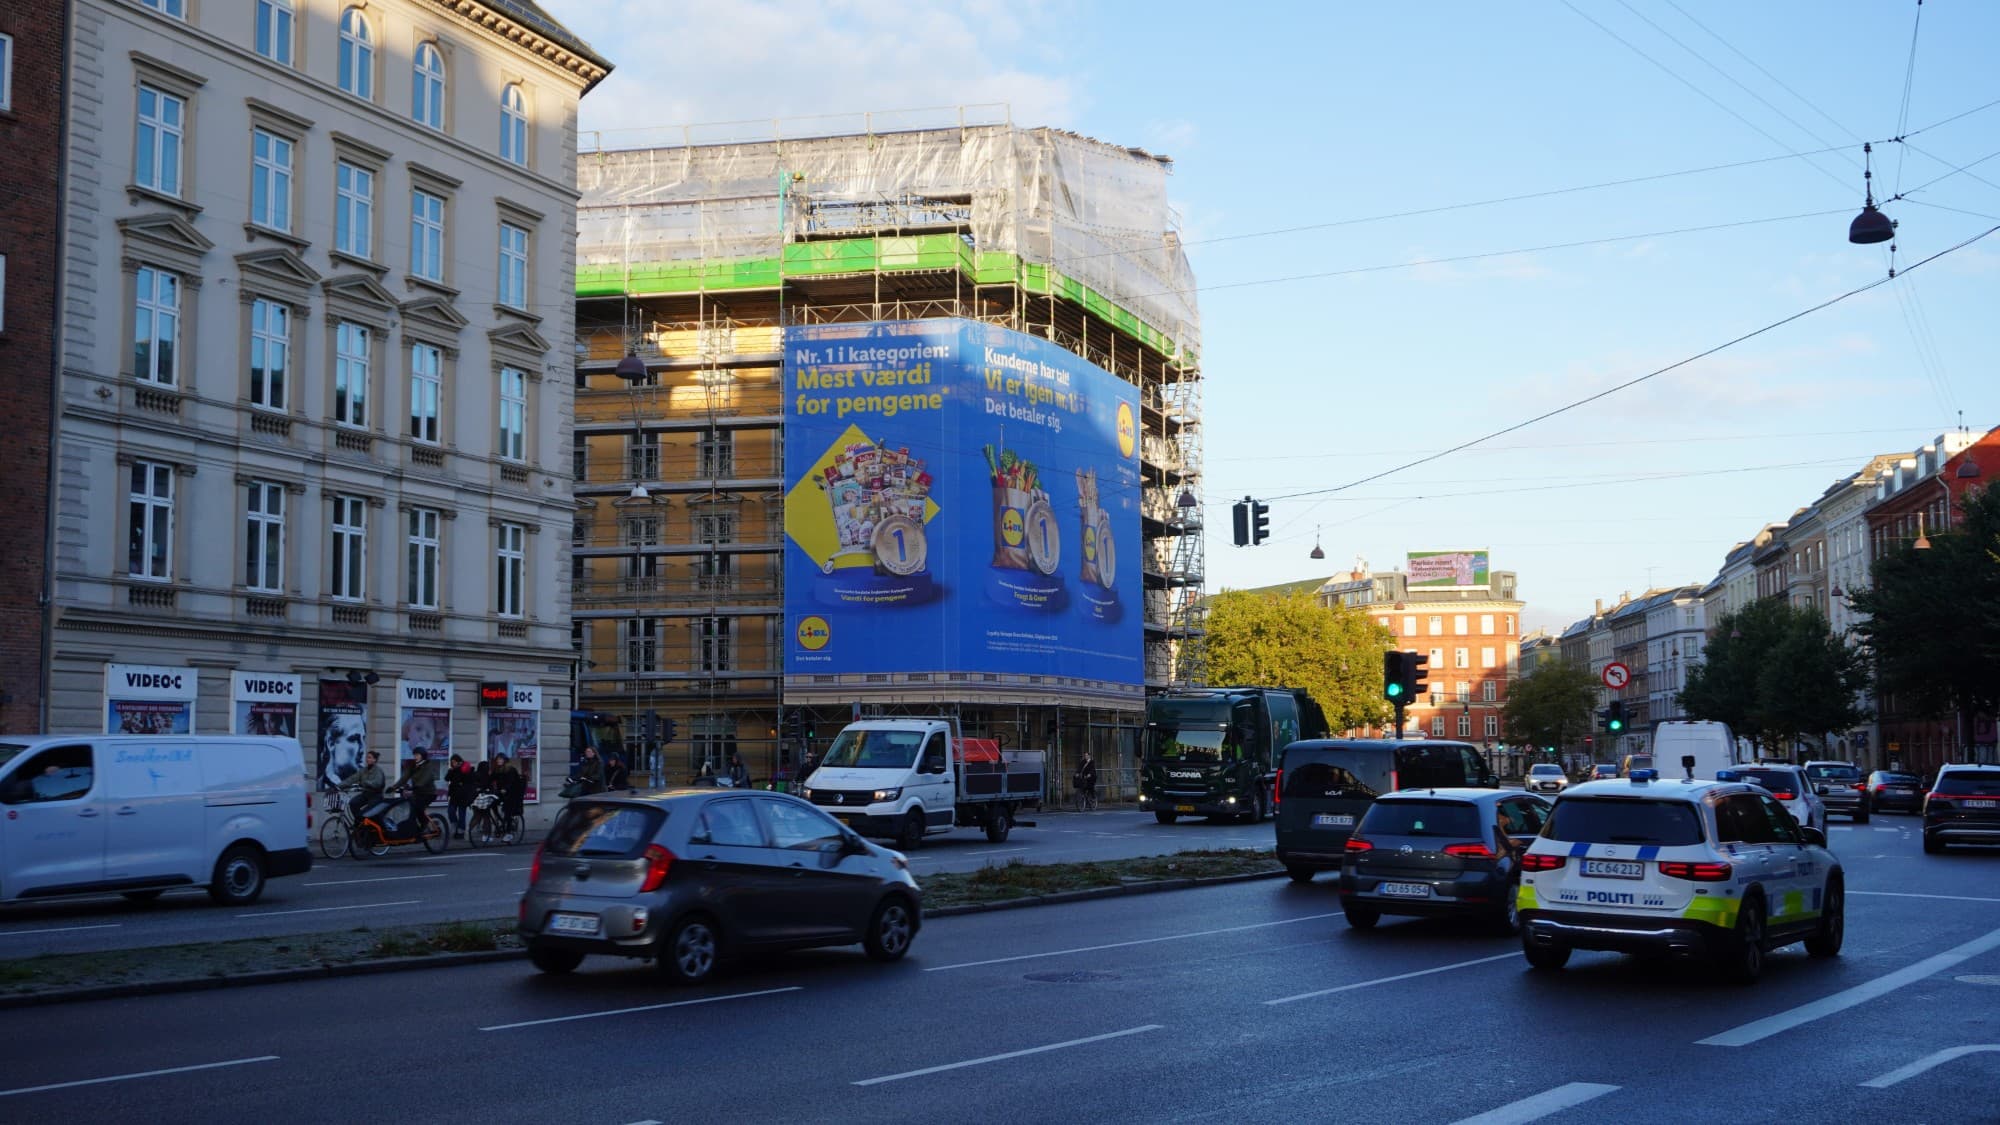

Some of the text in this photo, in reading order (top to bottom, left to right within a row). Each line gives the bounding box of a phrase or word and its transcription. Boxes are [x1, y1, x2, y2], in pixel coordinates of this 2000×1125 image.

[796, 342, 949, 364] Nr. 1 i kategorien:
[985, 346, 1039, 375] Kunderne
[1040, 360, 1055, 380] har
[796, 362, 931, 390] Mest værdi
[984, 368, 1002, 392] Vi
[1006, 378, 1022, 396] er
[1024, 375, 1053, 405] igen
[796, 394, 830, 415] for
[985, 397, 1062, 434] Det betaler sig.
[892, 528, 907, 562] 1
[1040, 518, 1049, 558] 1
[1170, 771, 1202, 779] SCANIA
[1588, 862, 1641, 875] EC 64 212
[1587, 891, 1634, 905] POLITI
